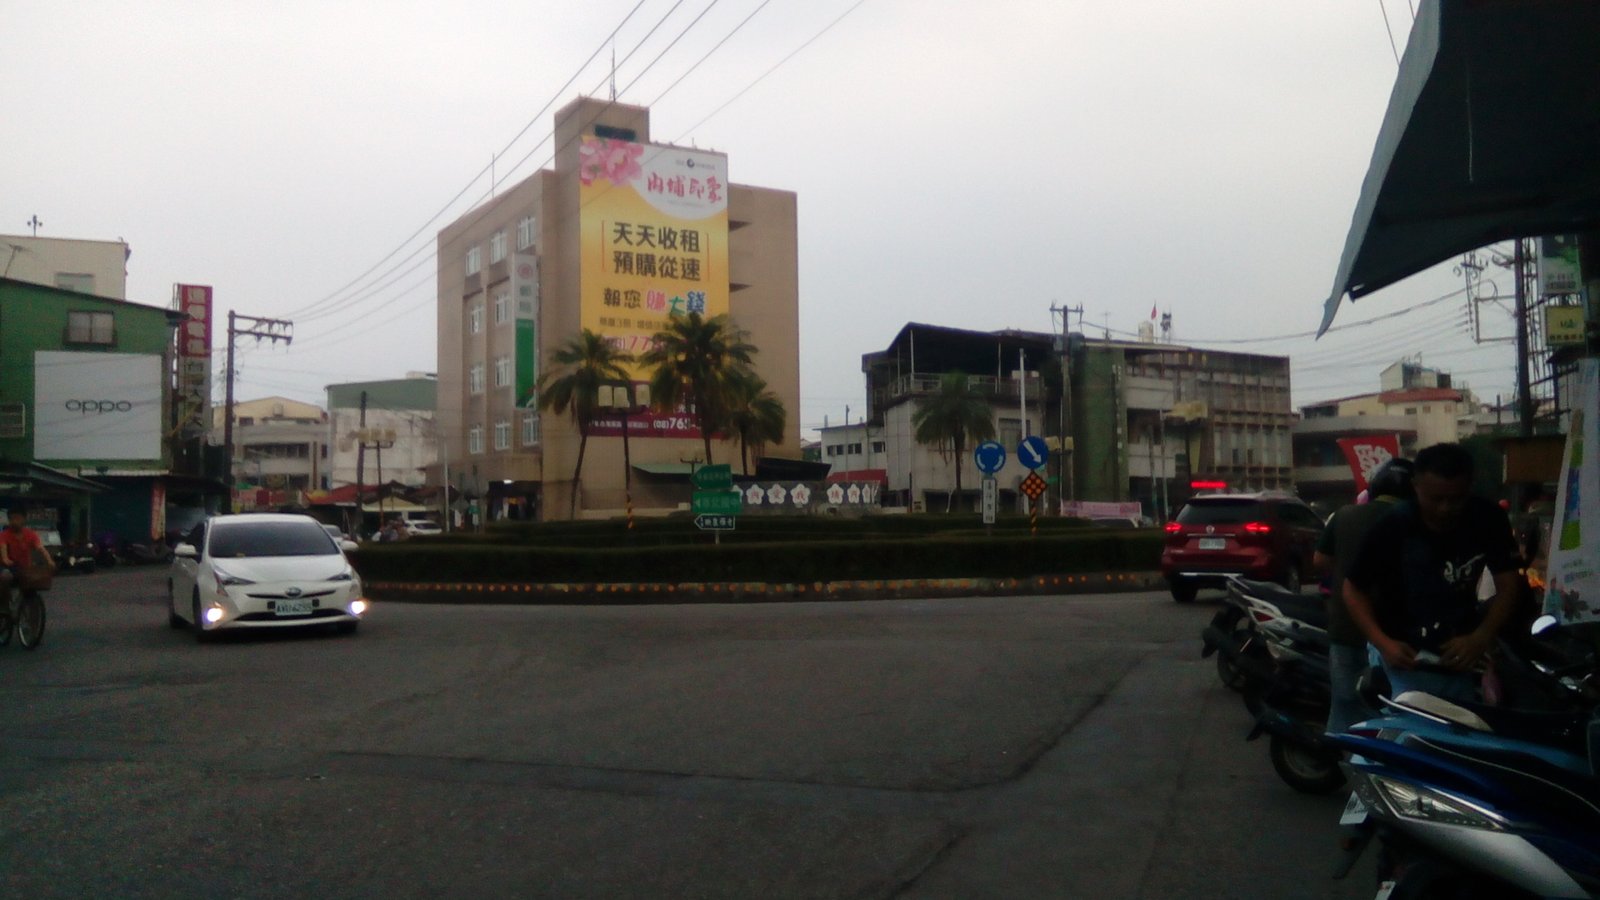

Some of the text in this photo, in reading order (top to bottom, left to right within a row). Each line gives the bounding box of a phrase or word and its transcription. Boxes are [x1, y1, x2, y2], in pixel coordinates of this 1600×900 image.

[647, 172, 722, 203] 內埔印象
[613, 222, 700, 253] 天天收租
[613, 251, 700, 281] 預購從速
